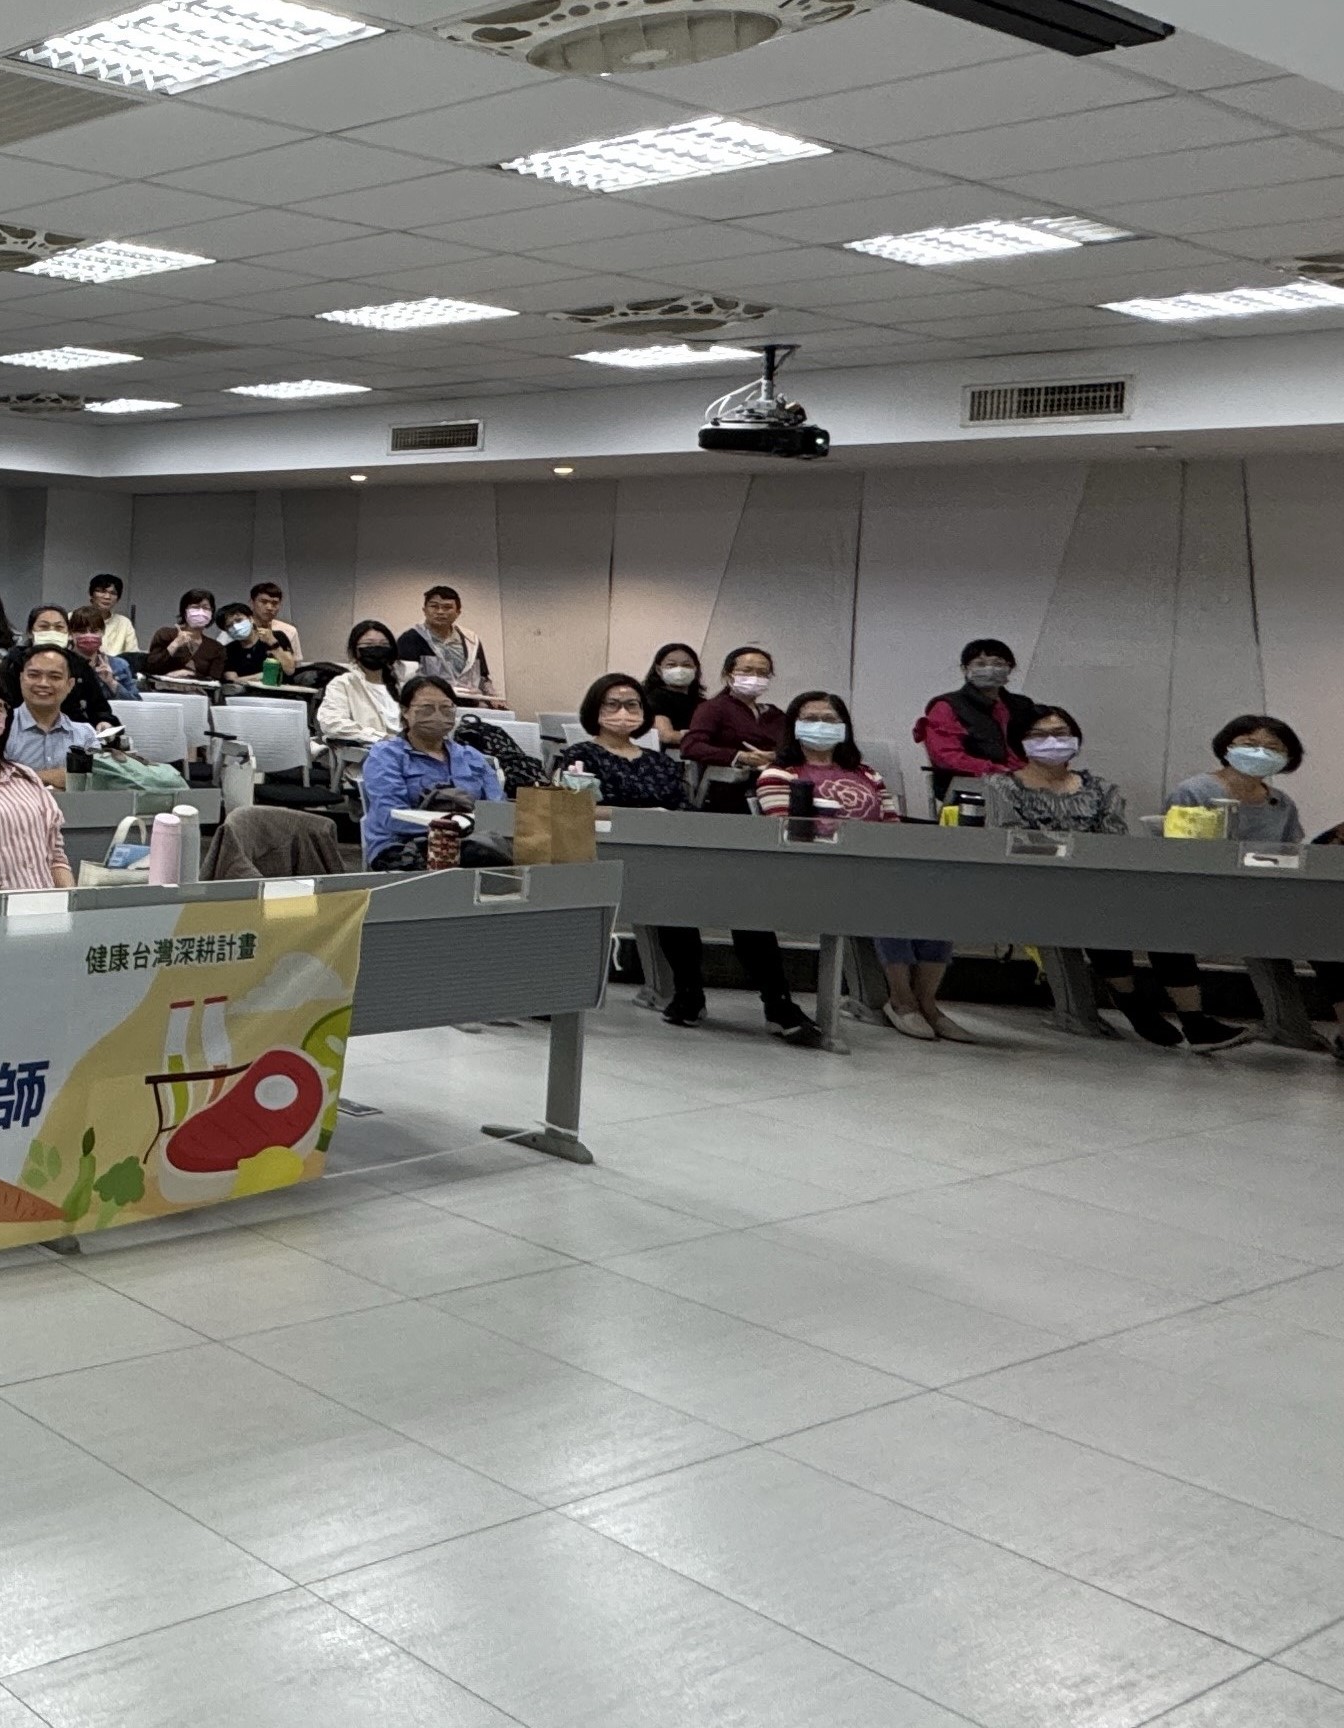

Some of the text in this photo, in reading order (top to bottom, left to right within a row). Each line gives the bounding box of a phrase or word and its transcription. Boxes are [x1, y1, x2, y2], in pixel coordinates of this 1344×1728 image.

[85, 932, 257, 975] 健康台灣深耕計畫
